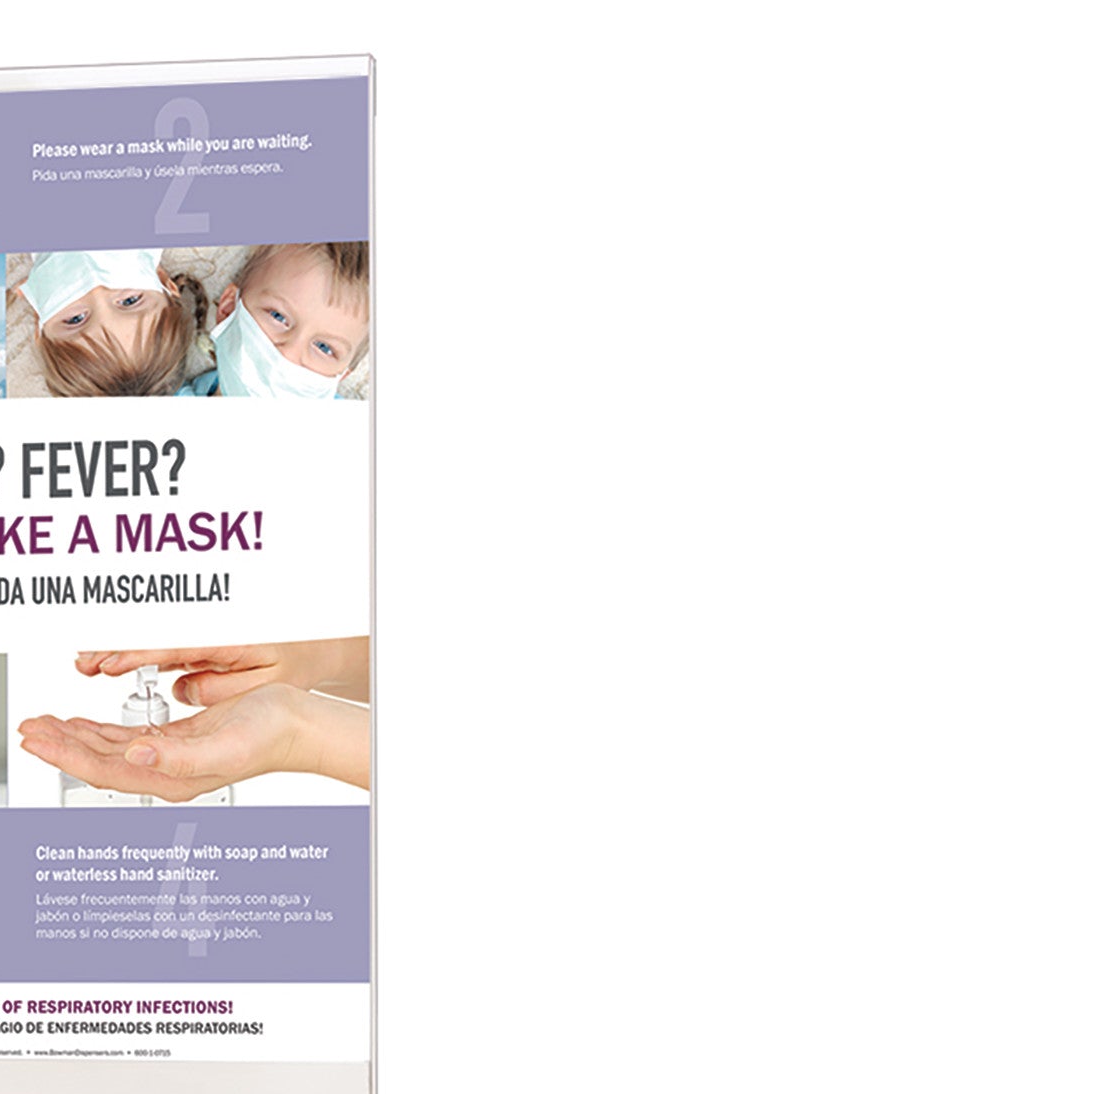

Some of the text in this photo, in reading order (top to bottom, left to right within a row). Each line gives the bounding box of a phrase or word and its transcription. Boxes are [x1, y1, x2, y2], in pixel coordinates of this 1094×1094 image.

[32, 133, 312, 158] Please wear a mask while you are waiting.
[153, 97, 210, 234] 2
[22, 439, 186, 498] FEVER?
[67, 514, 100, 554] A
[115, 510, 263, 552] MASK!
[31, 575, 76, 605] UNA
[82, 573, 230, 604] MASCARILLA!
[35, 844, 329, 862] Clean hands frequently with soap and water
[35, 866, 219, 882] or waterless hand sanitizer.
[151, 822, 216, 957] 4
[1, 999, 23, 1014] OF
[26, 999, 133, 1014] RESPIRATORY
[136, 999, 233, 1015] INFECTIONS!
[25, 1020, 44, 1035] DE
[46, 1020, 153, 1035] ENFERMEDADES
[155, 1021, 263, 1035] RESPIRATORIAS!
